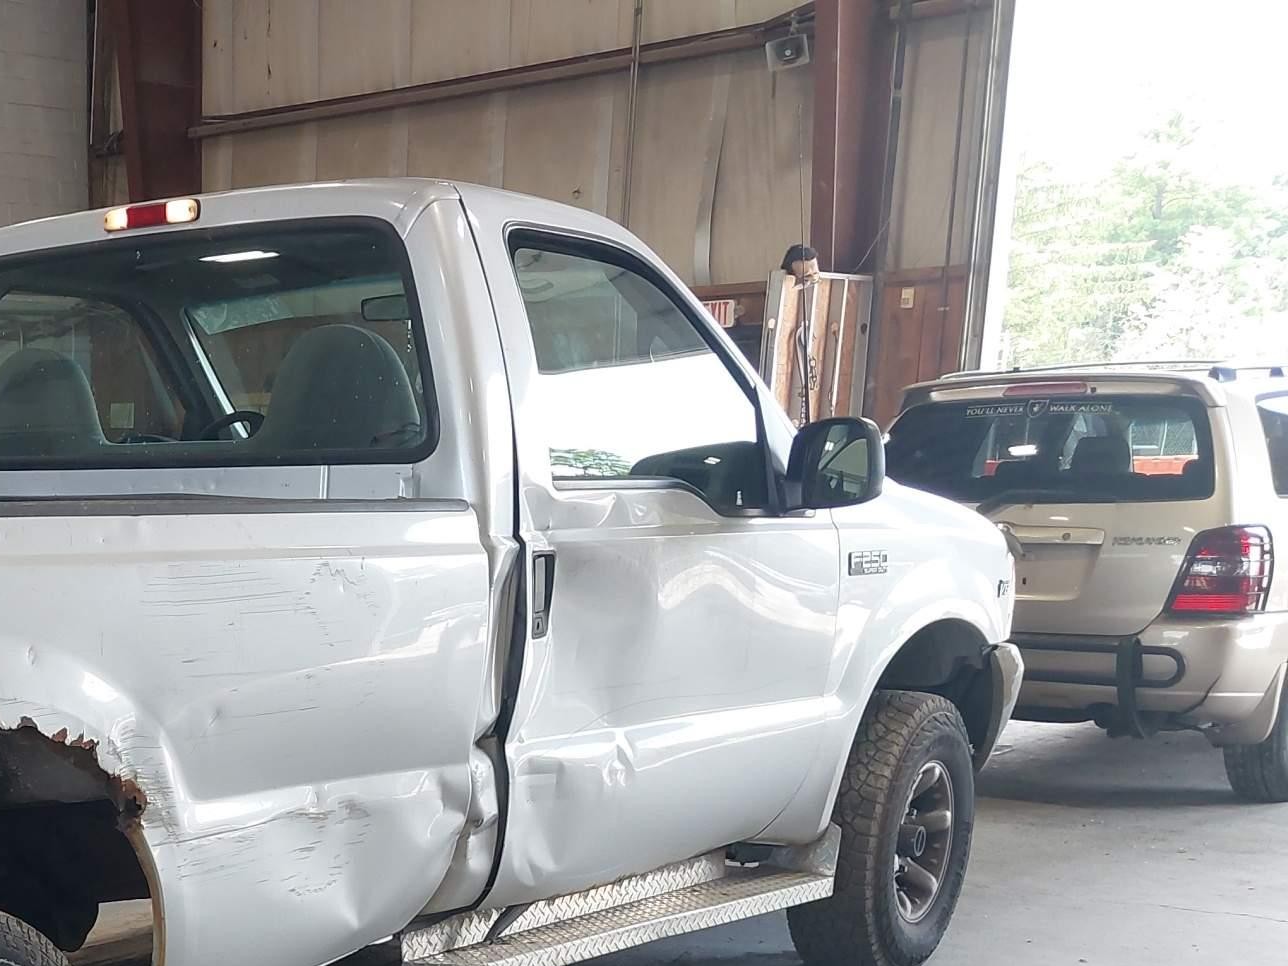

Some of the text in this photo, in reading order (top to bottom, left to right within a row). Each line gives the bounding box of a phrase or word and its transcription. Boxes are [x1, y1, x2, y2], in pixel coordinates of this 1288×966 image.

[996, 406, 1023, 415] NEVER
[1049, 404, 1077, 413] WALK
[1078, 404, 1113, 413] ALONE
